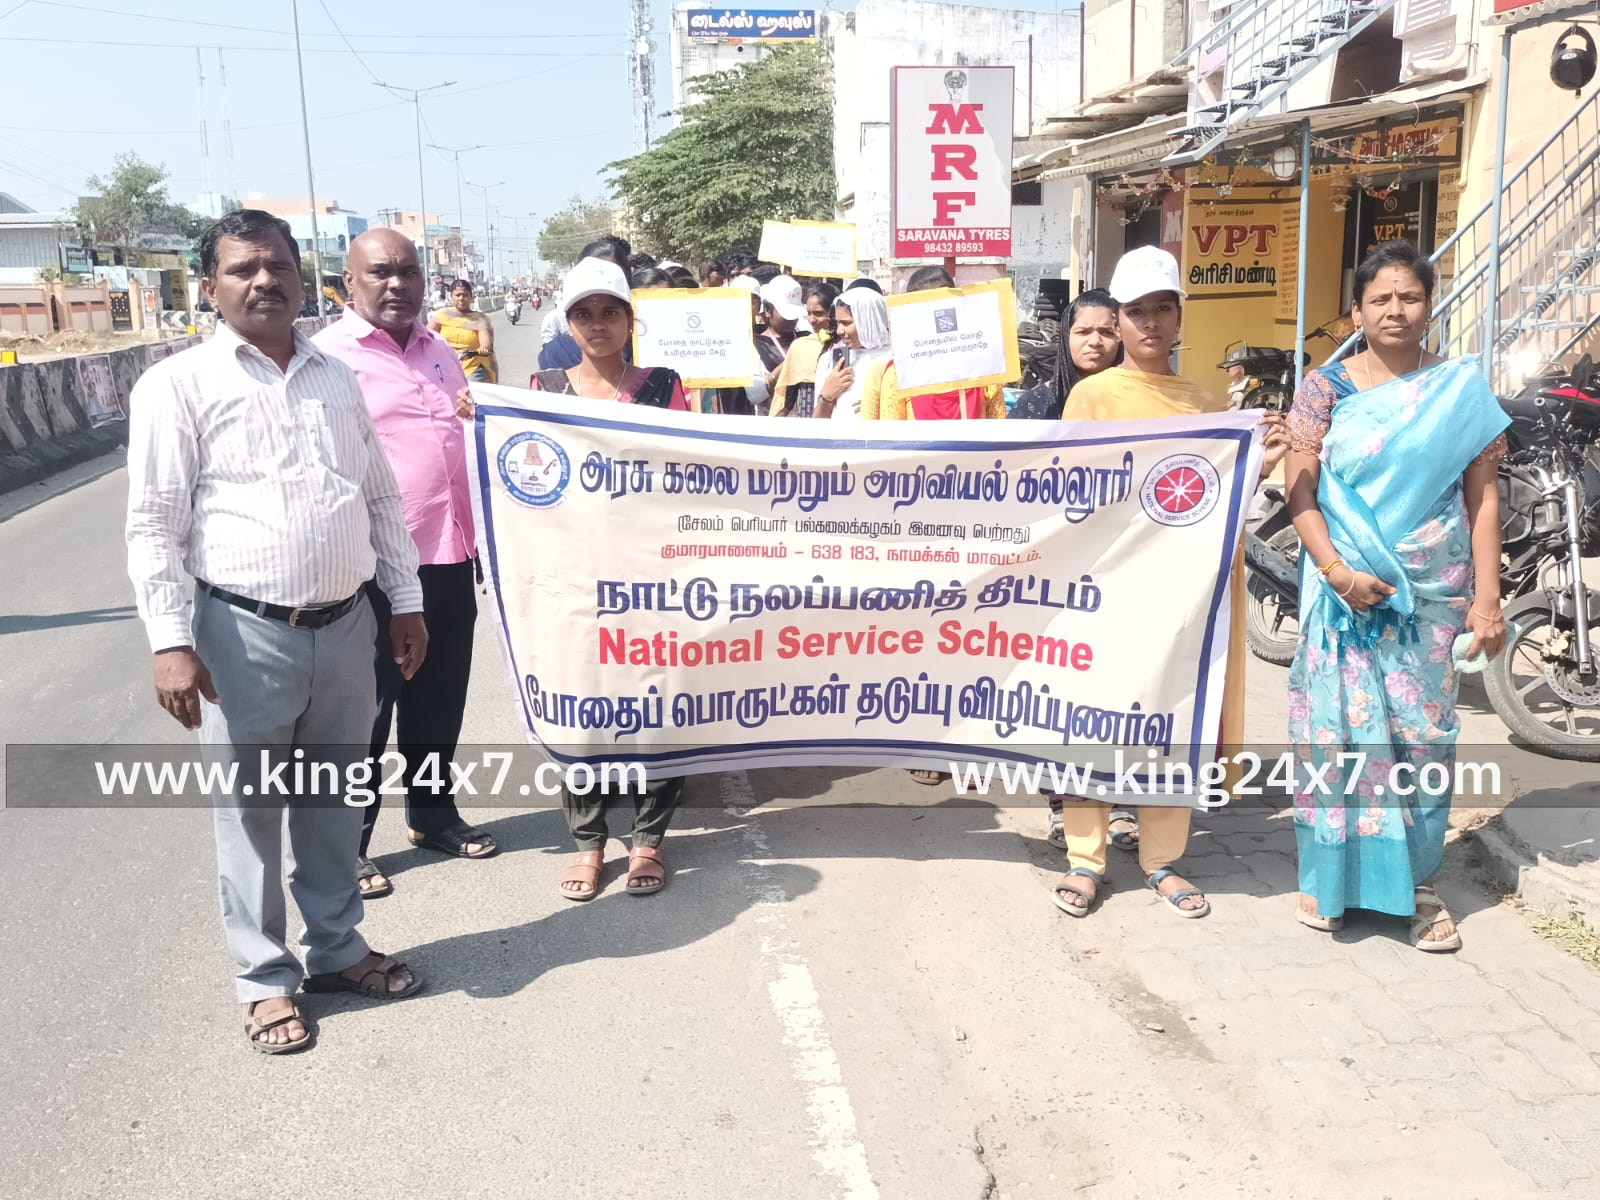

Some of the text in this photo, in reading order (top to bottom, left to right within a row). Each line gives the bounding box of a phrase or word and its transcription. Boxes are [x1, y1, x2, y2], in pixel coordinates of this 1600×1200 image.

[925, 103, 985, 226] MRF
[897, 229, 1010, 241] SARAVANA TYRES
[924, 242, 984, 253] 98432 89593
[1190, 223, 1279, 257] VPT
[1189, 260, 1277, 287] அரிசி மண்டி
[579, 450, 1134, 524] அரசு கலை மற்றும் அறிவியல் கல்லூரி
[677, 514, 724, 533] (சேலம்
[731, 516, 788, 533] பெரியார்
[795, 517, 902, 538] பல்கலைக்கழகம்
[661, 541, 787, 559] குமாரபாளையம்
[811, 544, 842, 560] 638
[850, 545, 880, 562] 183,
[887, 545, 960, 564] நாமக்கல்
[596, 576, 720, 622] நாட்டு
[729, 574, 967, 623] நலப்பணித்
[598, 619, 1094, 672] National Service Scheme
[525, 671, 1174, 757] போதைப் பொருட்கள் தடுப்பு விழிப்புணர்வு
